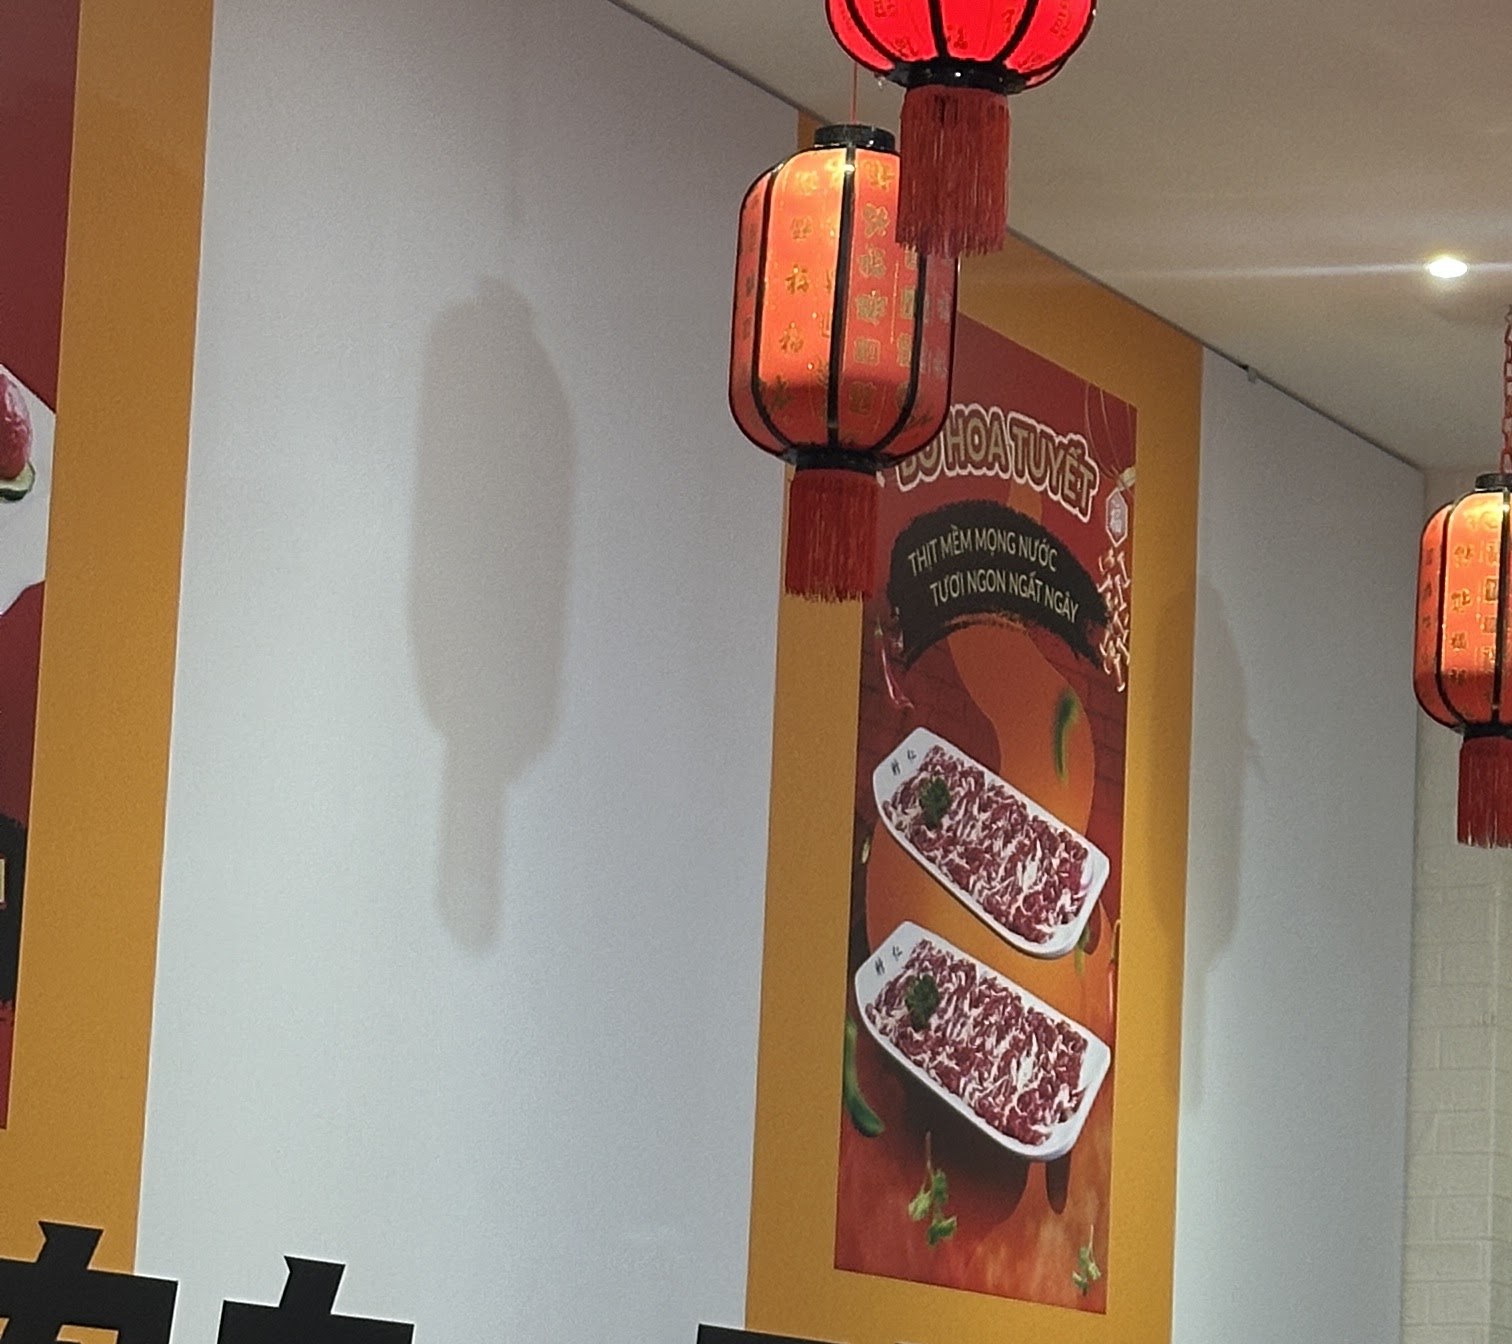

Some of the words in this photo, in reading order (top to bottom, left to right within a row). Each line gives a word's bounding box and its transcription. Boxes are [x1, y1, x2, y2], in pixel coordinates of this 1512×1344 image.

[944, 407, 1008, 475] HOA
[1010, 416, 1096, 517] TUYẾT
[908, 538, 938, 576] THỊT
[974, 527, 1016, 556] MỌNG
[1018, 533, 1058, 572] NƯỚC
[930, 571, 964, 606] TƯƠI
[967, 568, 1007, 594] NGON
